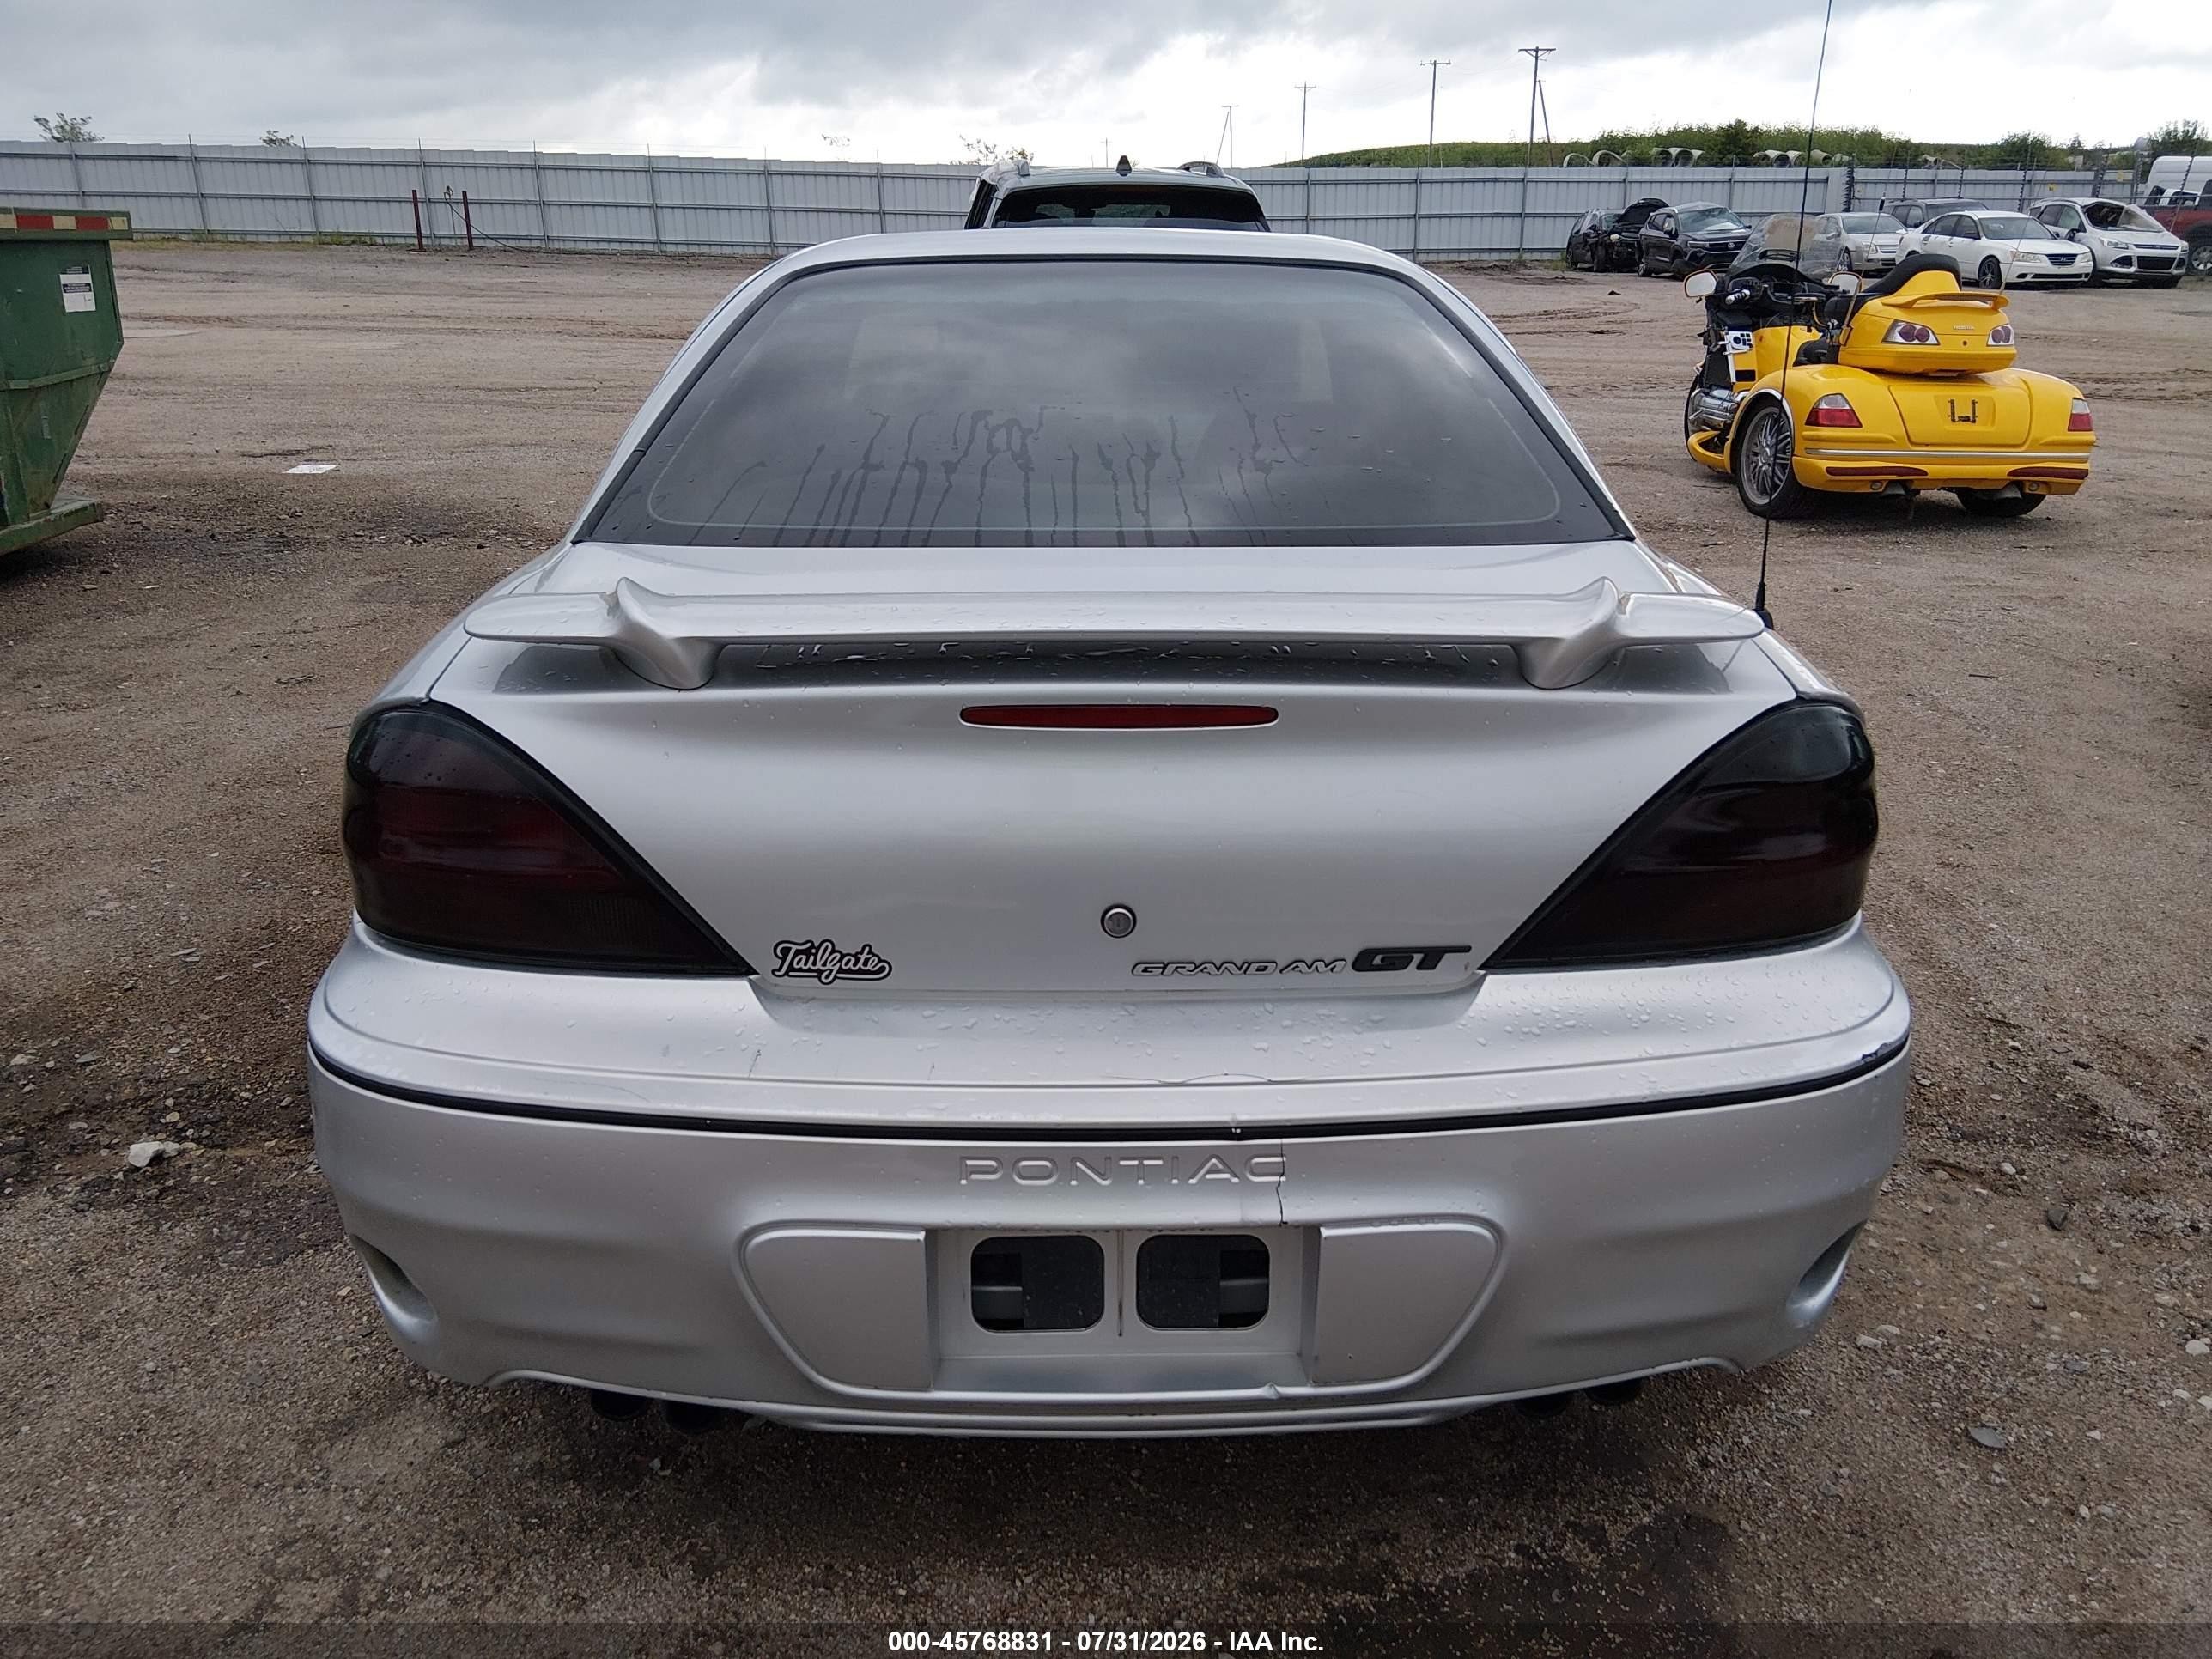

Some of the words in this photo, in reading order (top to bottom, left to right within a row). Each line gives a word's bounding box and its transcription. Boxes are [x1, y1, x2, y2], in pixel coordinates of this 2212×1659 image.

[771, 939, 893, 986] Tailgate
[1131, 961, 1278, 976] GRAND
[1279, 958, 1348, 975] AM
[1352, 945, 1472, 972] GT
[958, 1155, 1286, 1186] PONTIAC
